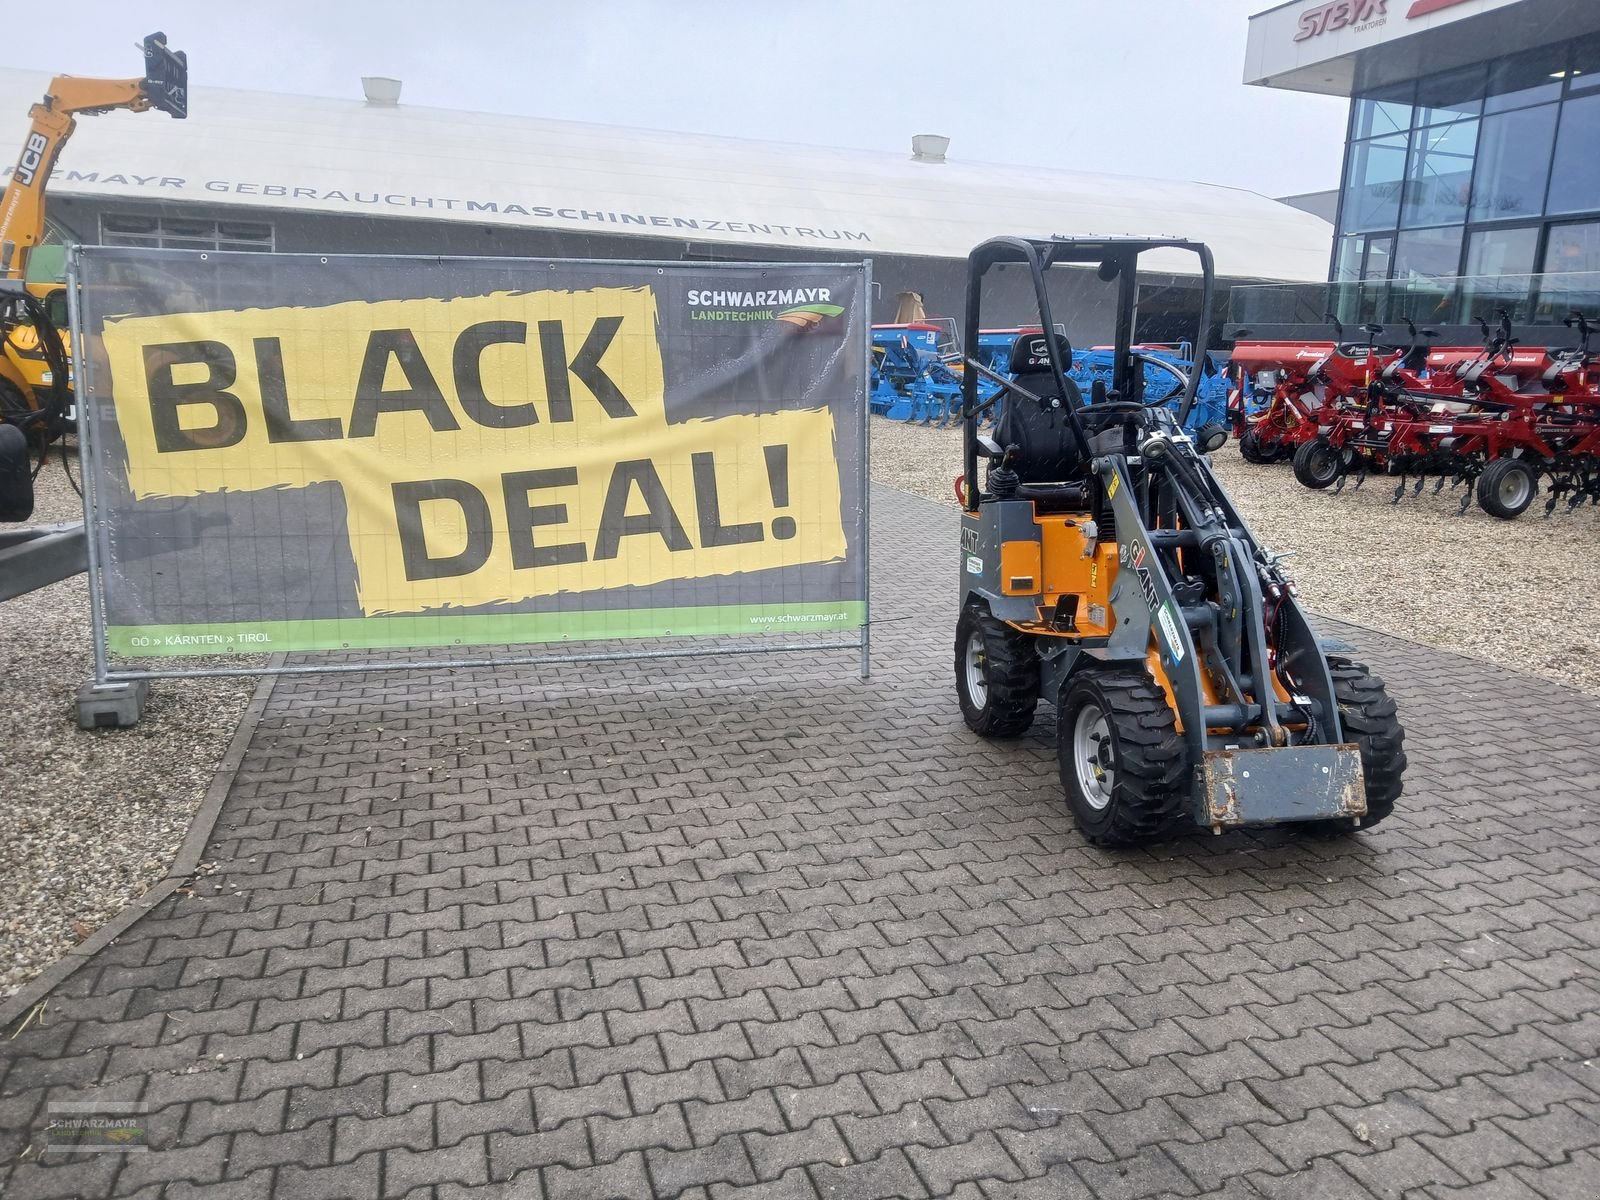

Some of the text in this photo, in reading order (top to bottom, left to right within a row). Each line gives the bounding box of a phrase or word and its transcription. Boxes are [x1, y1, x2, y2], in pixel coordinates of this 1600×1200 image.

[1354, 17, 1387, 33] TRAKTOREN
[18, 132, 48, 186] JCB
[204, 180, 871, 242] GEBRAUCHTMASCHINENZENTRUM
[687, 287, 831, 307] SCHWARZMAYR
[691, 309, 775, 322] LANDTECHNIK
[142, 316, 638, 454] BLACK
[391, 444, 798, 582] DEAL!
[1129, 538, 1160, 613] GIANT
[749, 612, 849, 625] www.schwarzmayr.at
[165, 634, 223, 646] KÄRNTEN
[237, 632, 273, 643] TIROL
